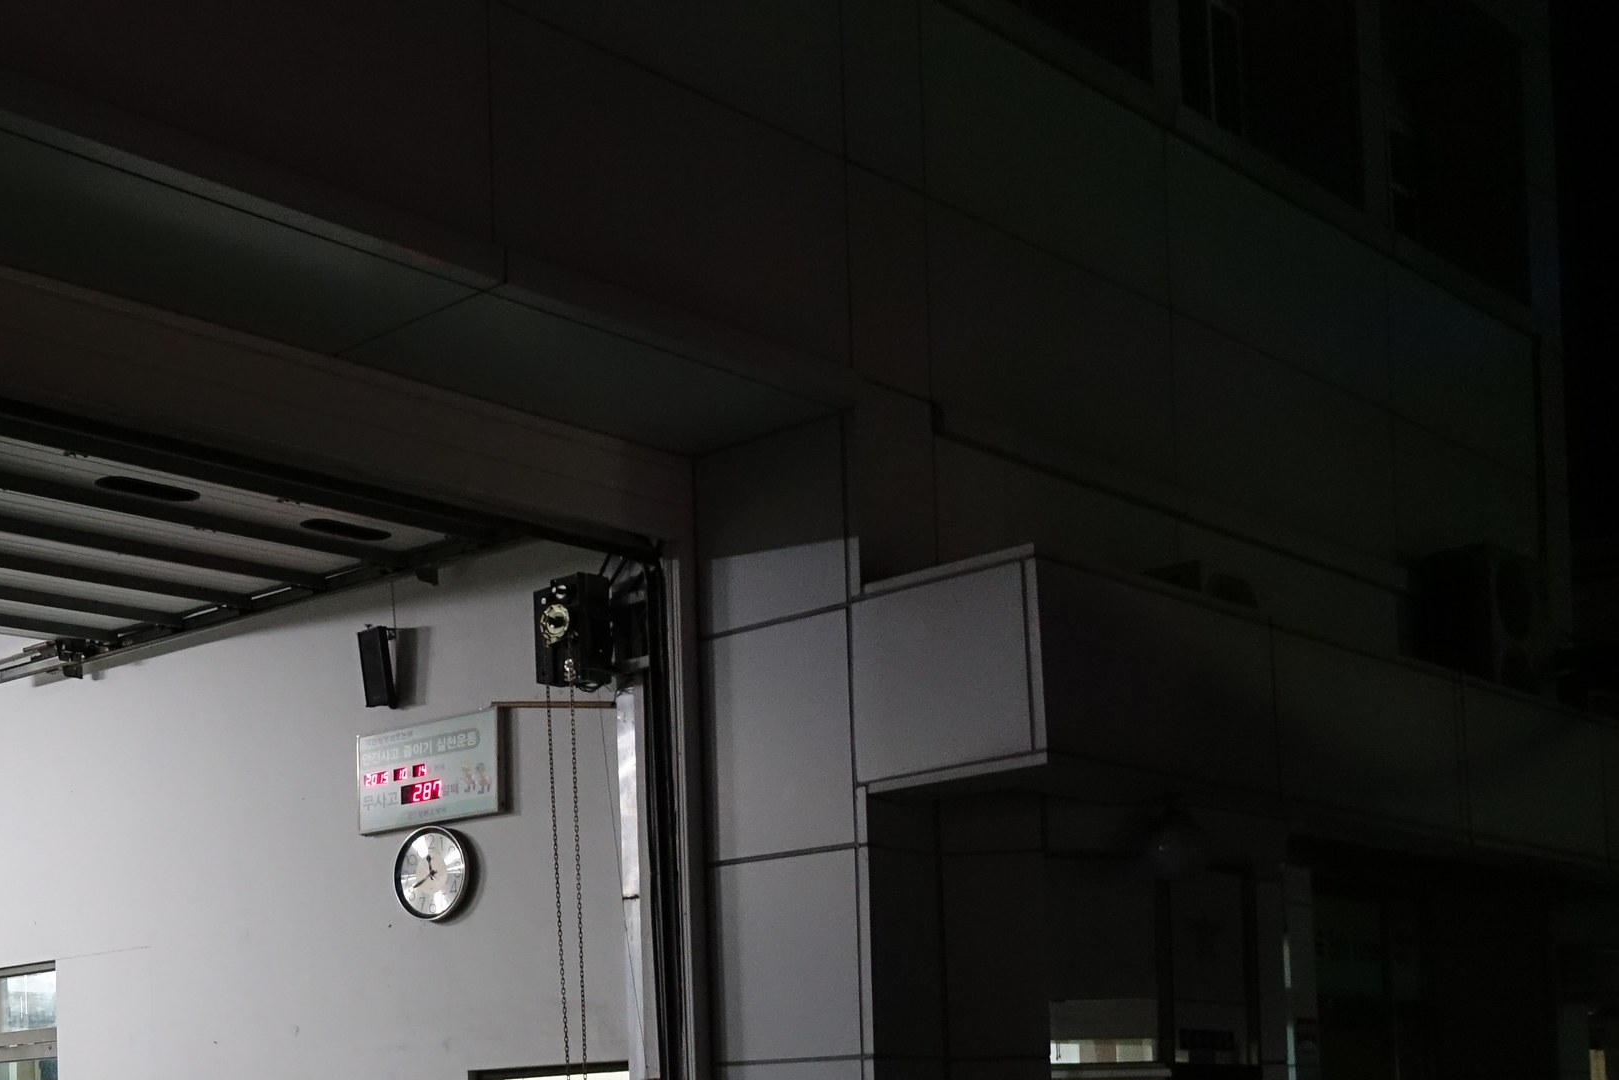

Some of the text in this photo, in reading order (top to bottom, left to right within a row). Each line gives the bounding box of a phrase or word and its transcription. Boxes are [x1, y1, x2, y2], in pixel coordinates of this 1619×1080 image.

[403, 741, 433, 758] 줄이기
[436, 730, 477, 752] 실천운동
[365, 772, 389, 787] 2015
[398, 768, 408, 780] 10
[417, 764, 427, 776] 14
[363, 790, 399, 811] 무사고
[413, 780, 441, 802] 287
